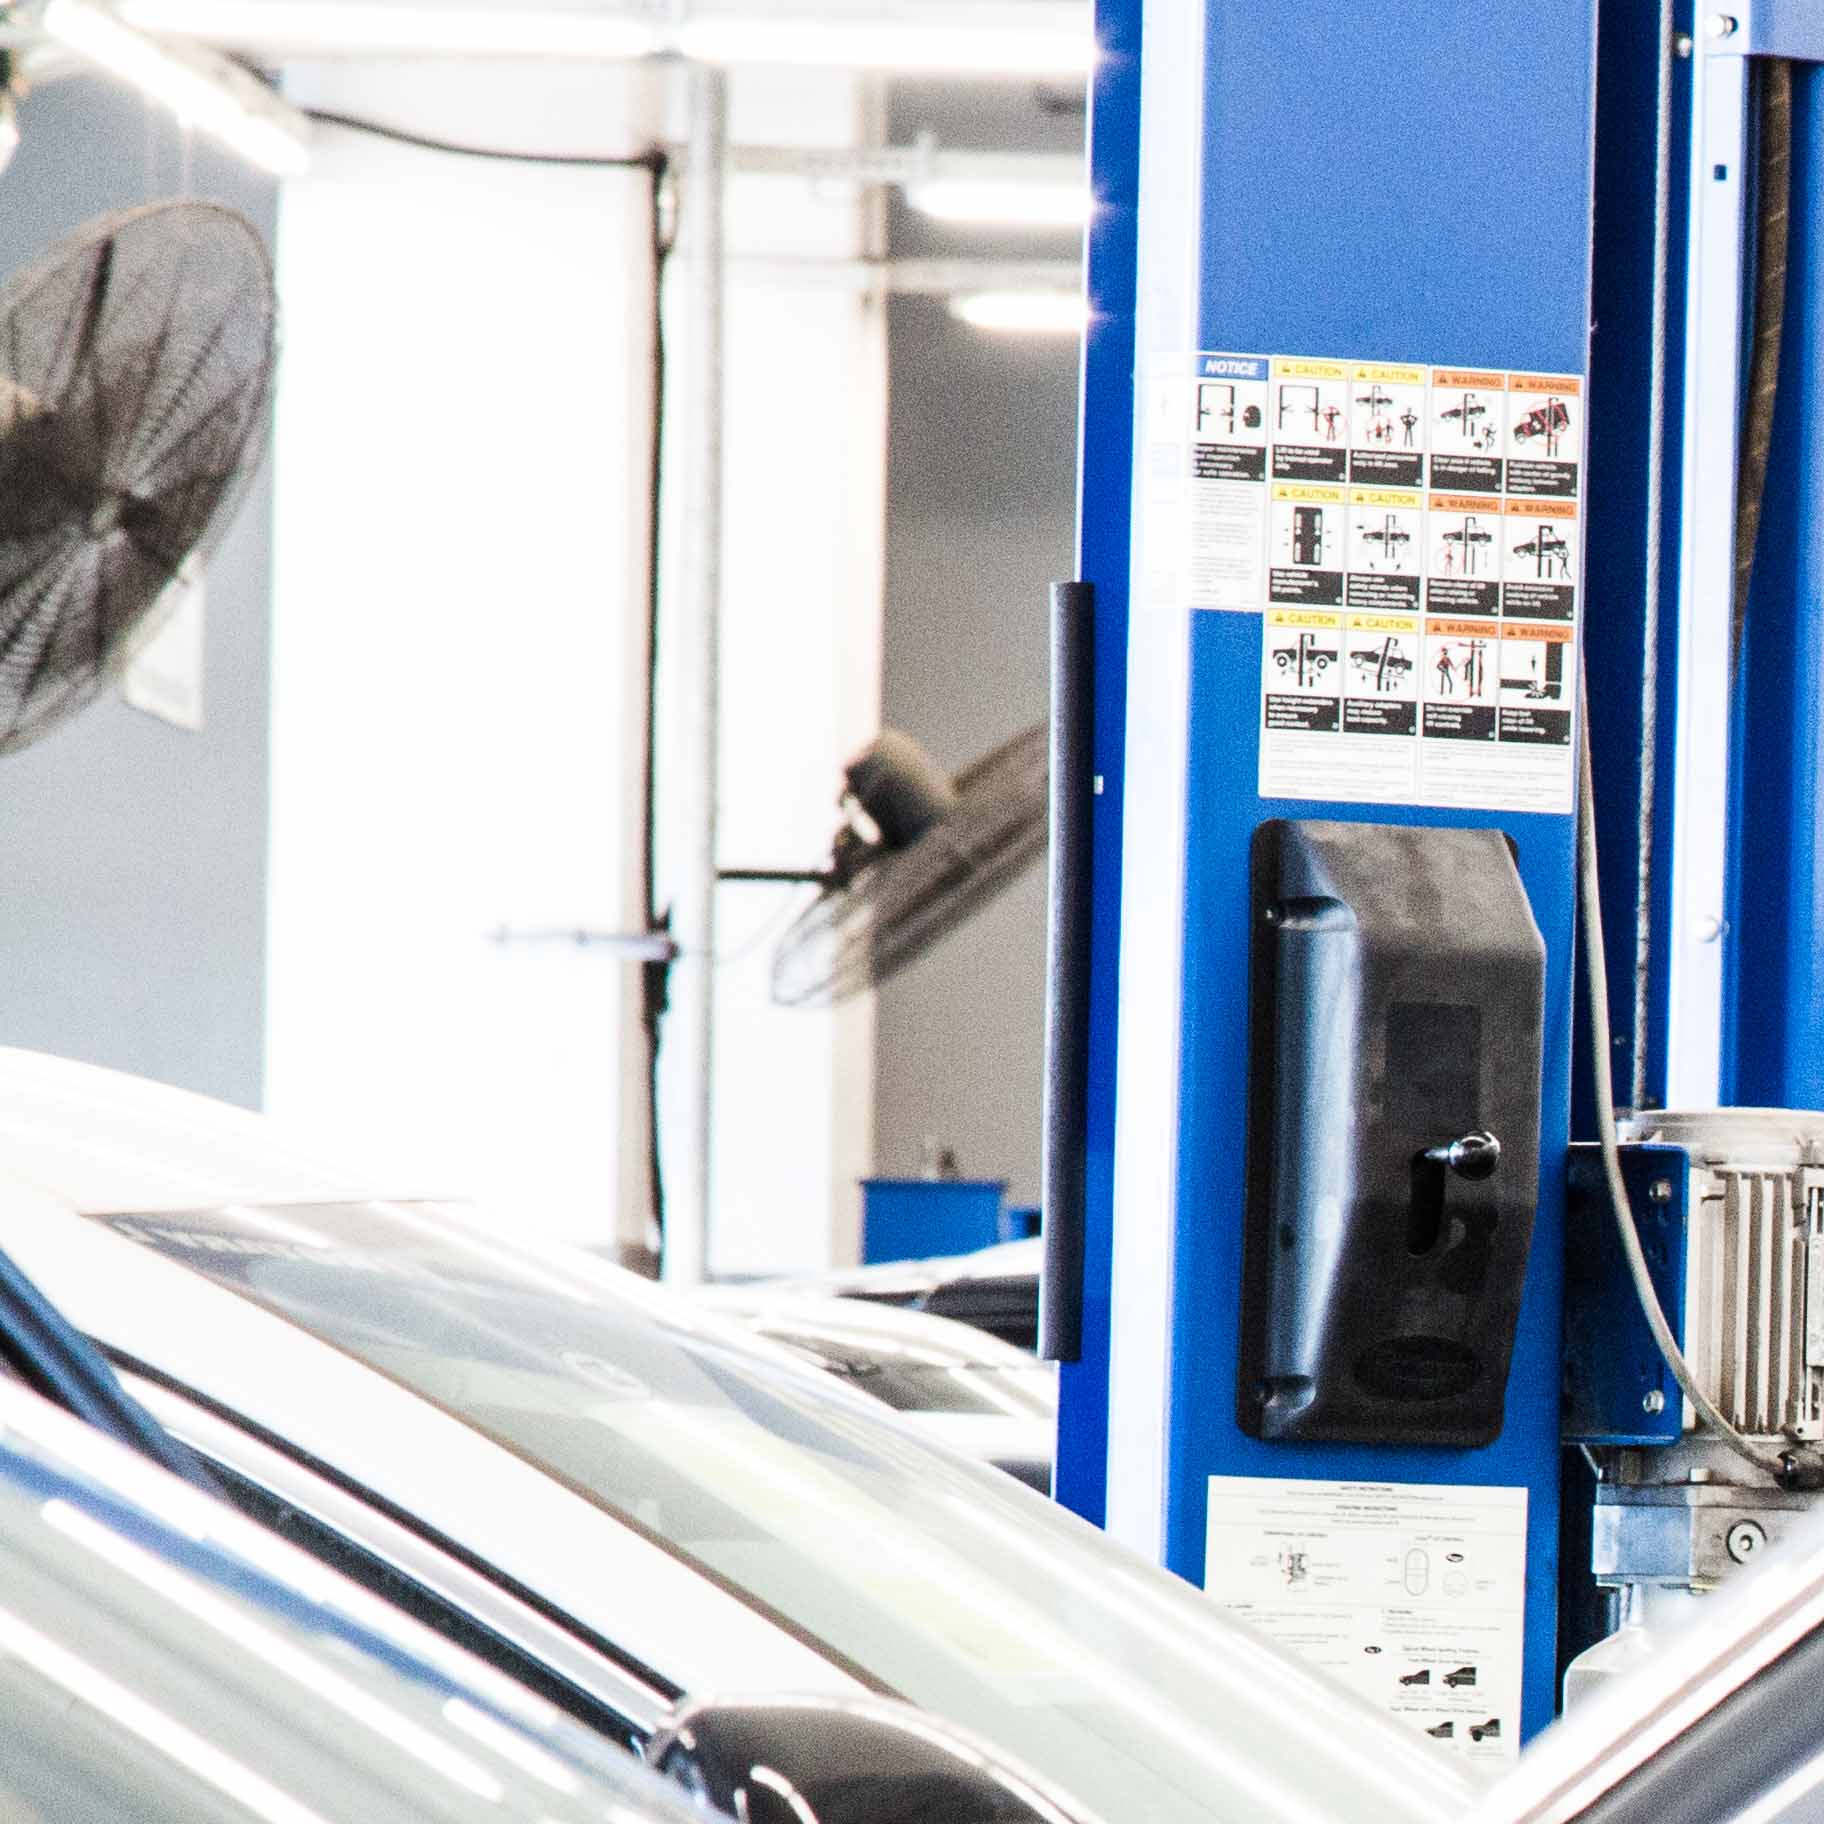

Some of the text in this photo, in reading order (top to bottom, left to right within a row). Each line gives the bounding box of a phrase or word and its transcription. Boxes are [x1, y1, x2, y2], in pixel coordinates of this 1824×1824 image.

[1205, 359, 1258, 376] NOTICE
[1295, 364, 1342, 376] CAUTION
[1371, 369, 1419, 381] CAUTION
[1453, 376, 1501, 387] WARNING
[1529, 382, 1577, 392] WARNING
[1291, 489, 1339, 500] CAUTION
[1368, 493, 1416, 505] CAUTION
[1448, 500, 1498, 511] WARNING
[1525, 505, 1574, 515] WARNING
[1288, 614, 1336, 625] CAUTION
[1366, 618, 1414, 629] CAUTION
[1446, 624, 1496, 635] WARNING
